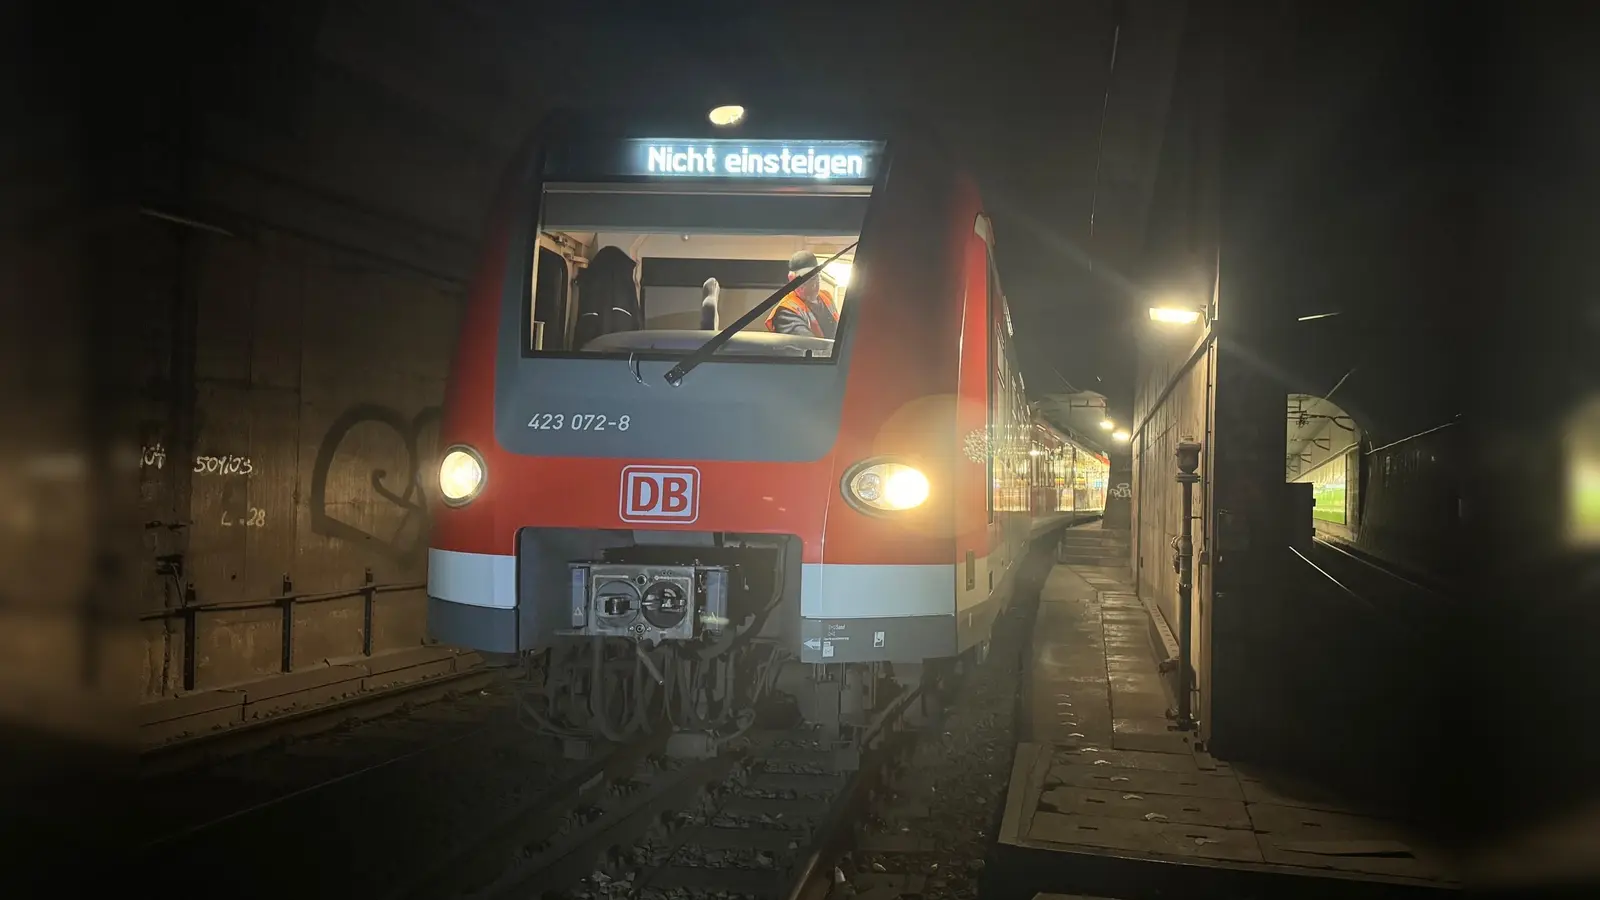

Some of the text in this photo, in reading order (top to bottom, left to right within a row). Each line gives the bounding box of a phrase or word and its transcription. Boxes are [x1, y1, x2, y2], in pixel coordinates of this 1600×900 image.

[648, 145, 863, 178] Nicht einsteigen
[527, 413, 631, 431] 423 072-8
[631, 476, 688, 513] DB
